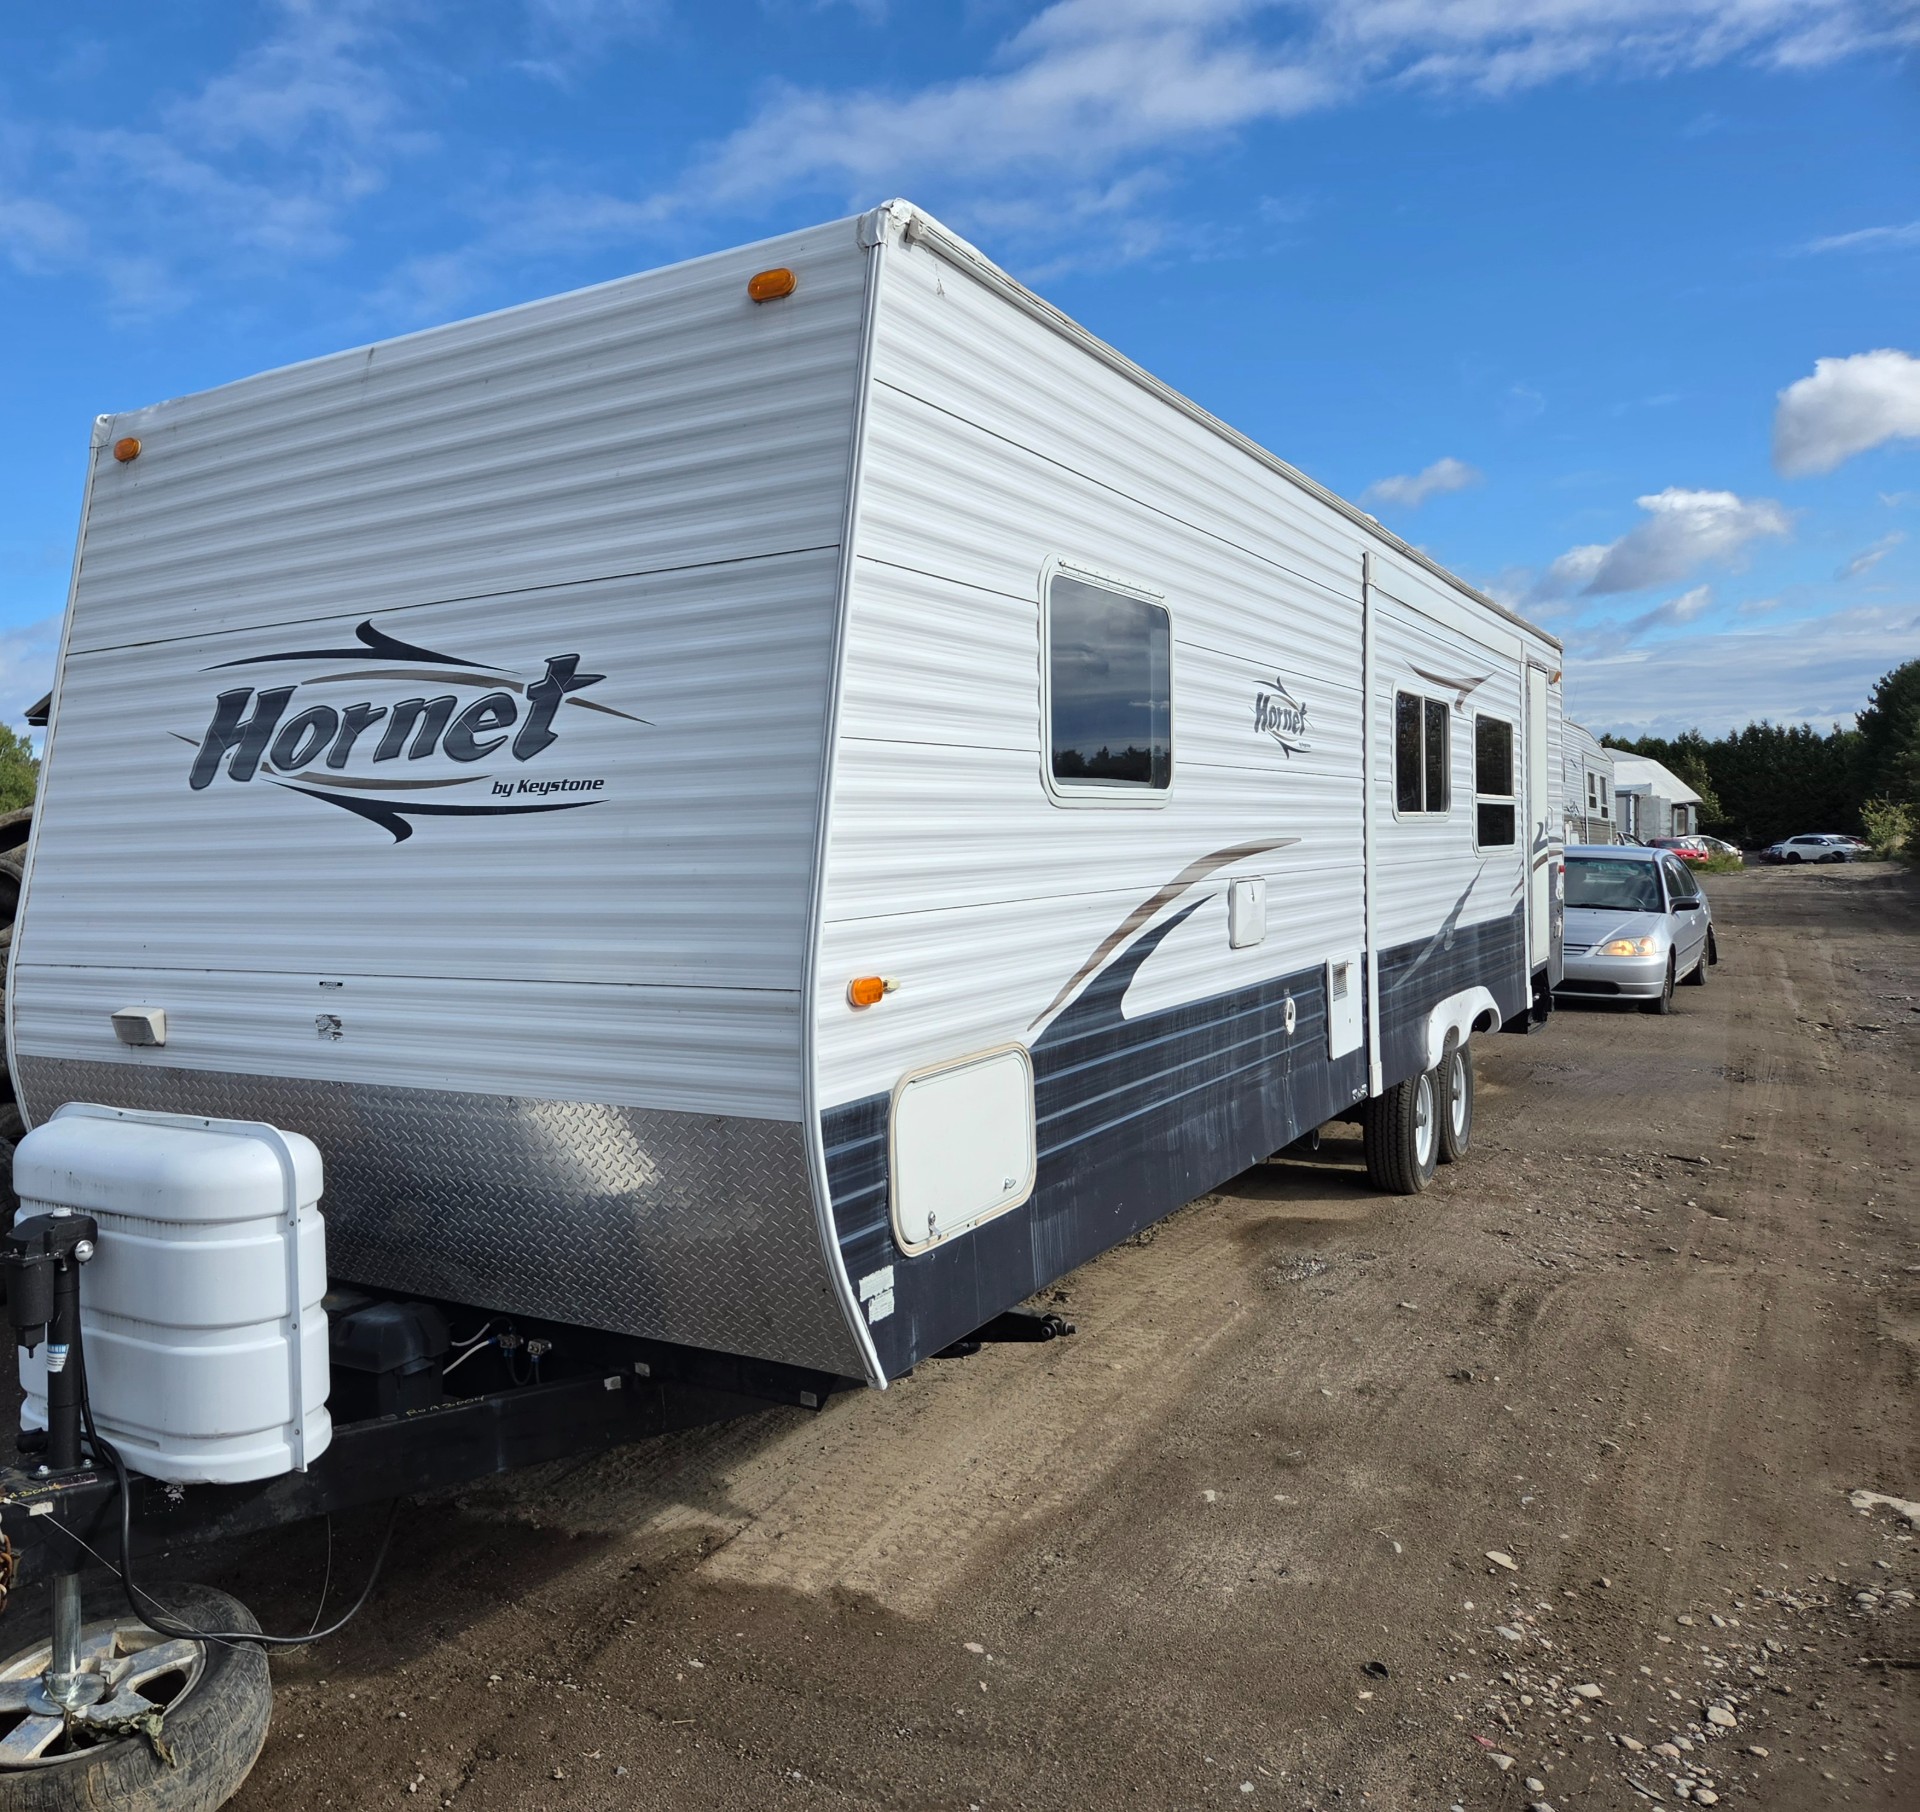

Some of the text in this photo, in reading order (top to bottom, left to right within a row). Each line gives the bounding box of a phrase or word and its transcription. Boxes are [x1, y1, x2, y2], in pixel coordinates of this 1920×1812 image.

[189, 653, 606, 790] Hornet
[1254, 692, 1307, 736] Hornet
[491, 779, 604, 797] by Keystone
